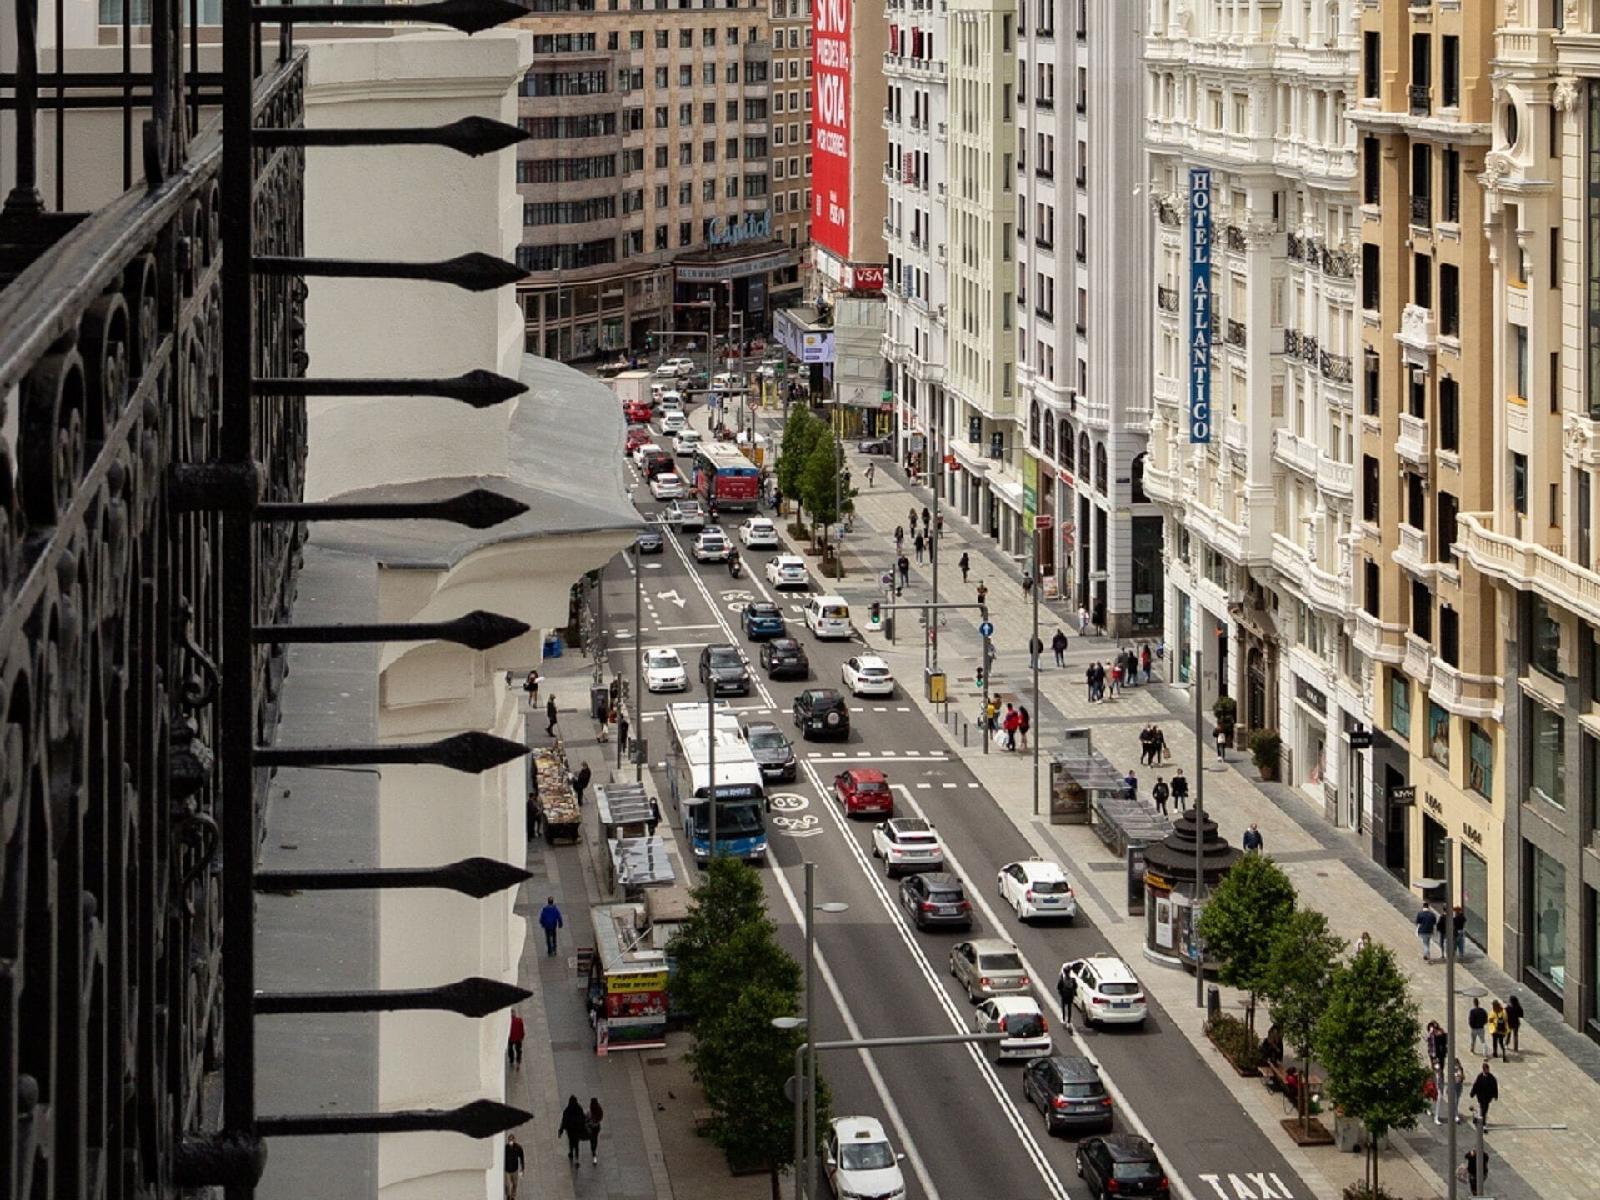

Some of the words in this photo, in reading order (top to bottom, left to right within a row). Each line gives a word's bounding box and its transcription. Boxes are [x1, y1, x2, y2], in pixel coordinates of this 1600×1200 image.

[816, 71, 847, 129] VOTA
[709, 208, 772, 246] Capitol
[1192, 172, 1209, 264] HOTEL
[1192, 275, 1209, 440] ATLANTICO
[1198, 1172, 1294, 1200] TAXI
